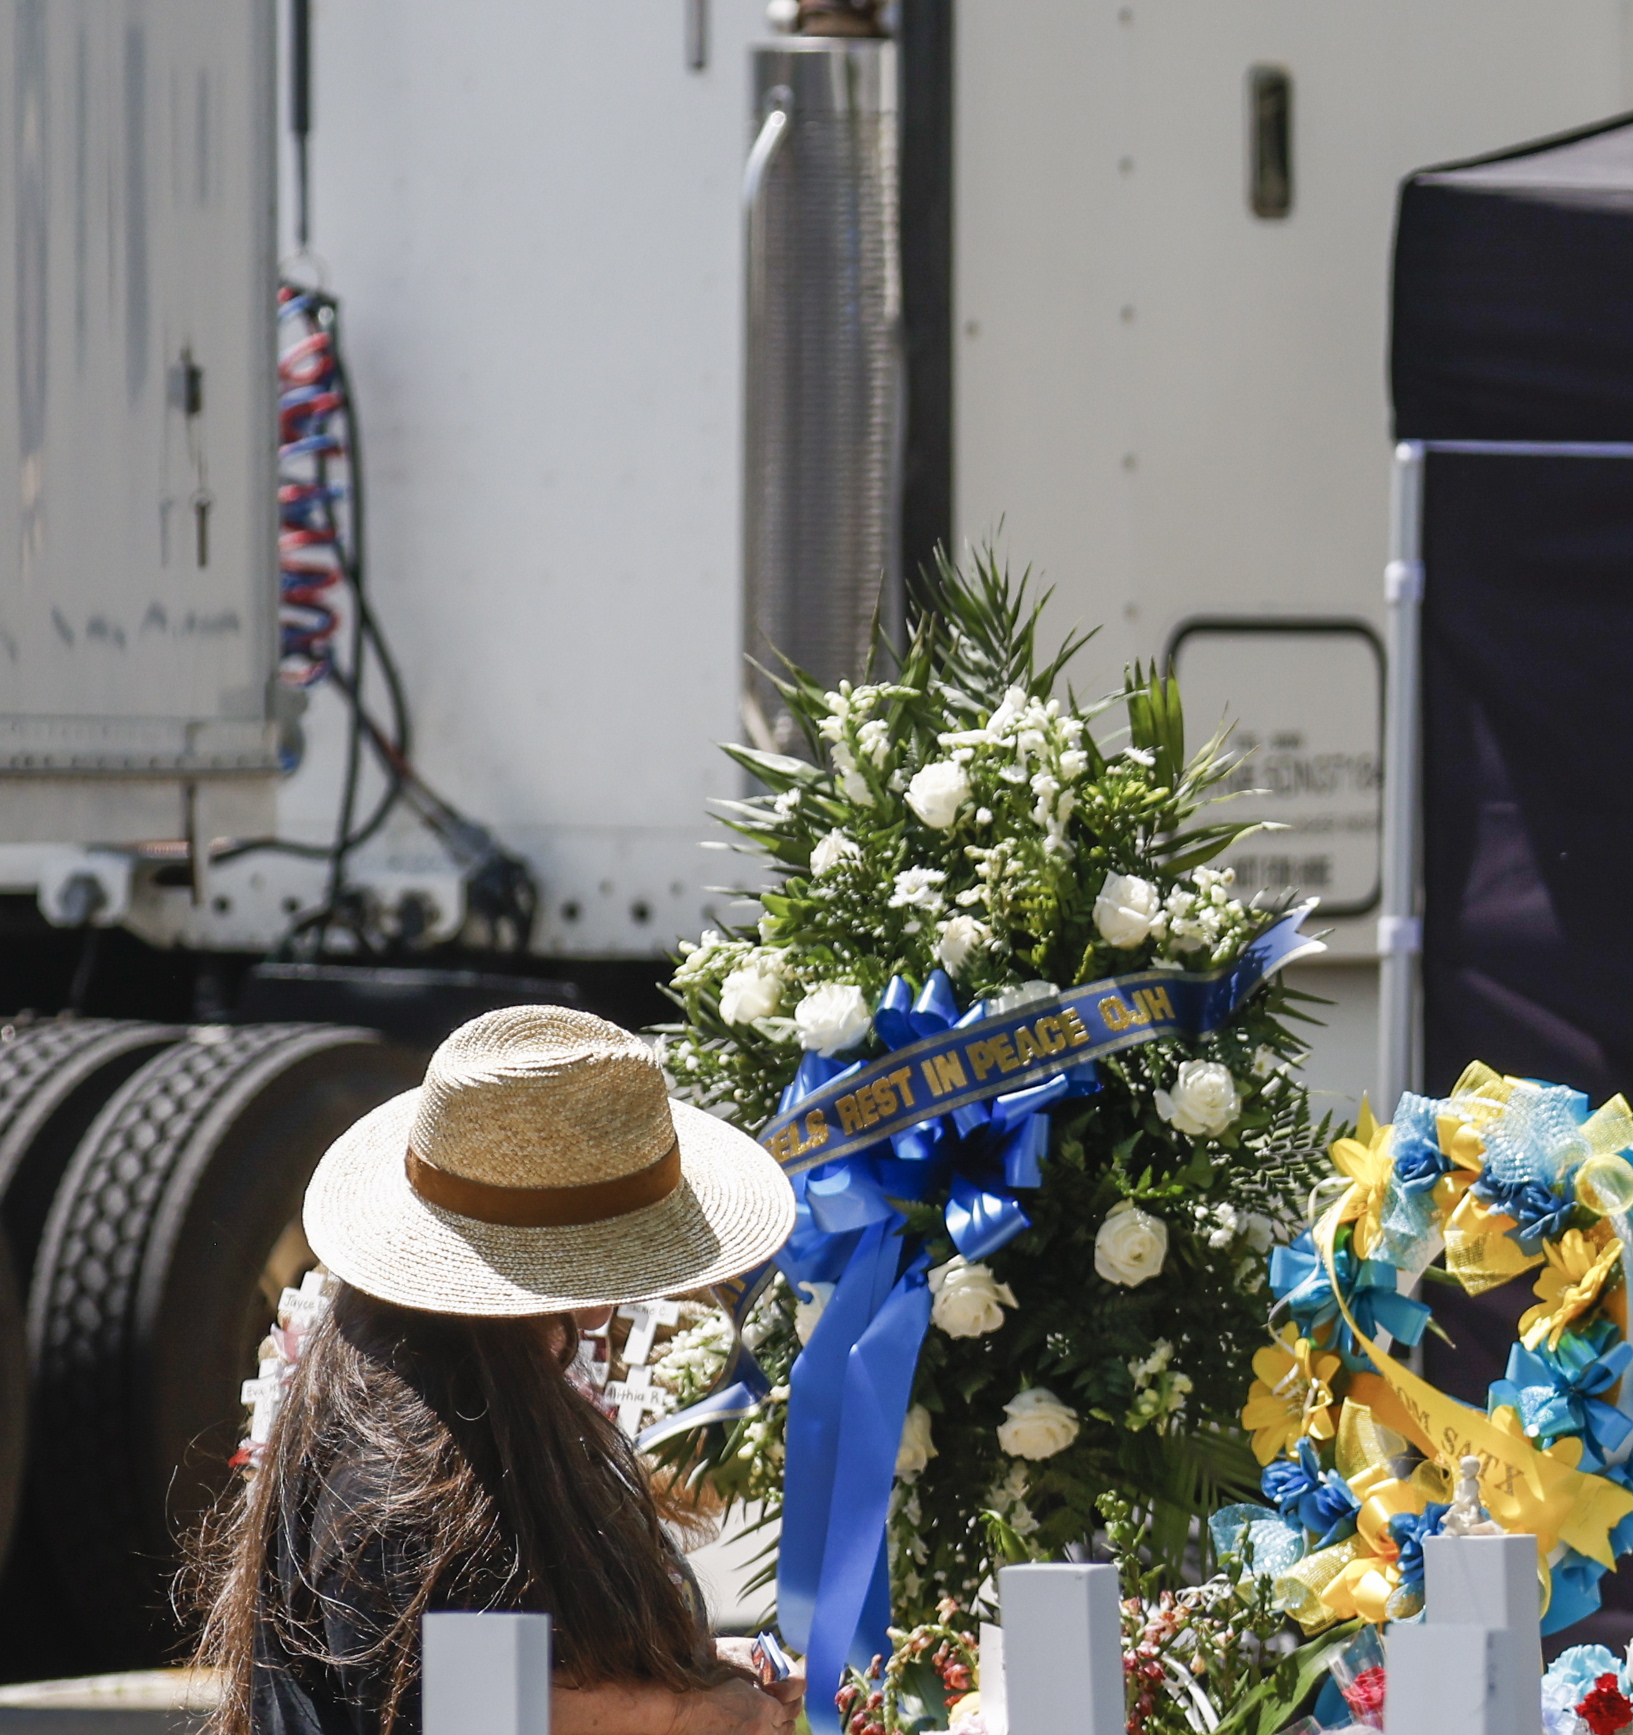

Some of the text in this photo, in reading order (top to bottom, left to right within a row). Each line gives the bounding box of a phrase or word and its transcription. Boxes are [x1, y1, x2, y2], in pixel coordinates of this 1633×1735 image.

[766, 1108, 829, 1164] ELS
[835, 1066, 915, 1136] REST
[920, 1050, 969, 1097] IN
[965, 1006, 1090, 1081] PEACE
[1441, 1427, 1524, 1496] SATX
